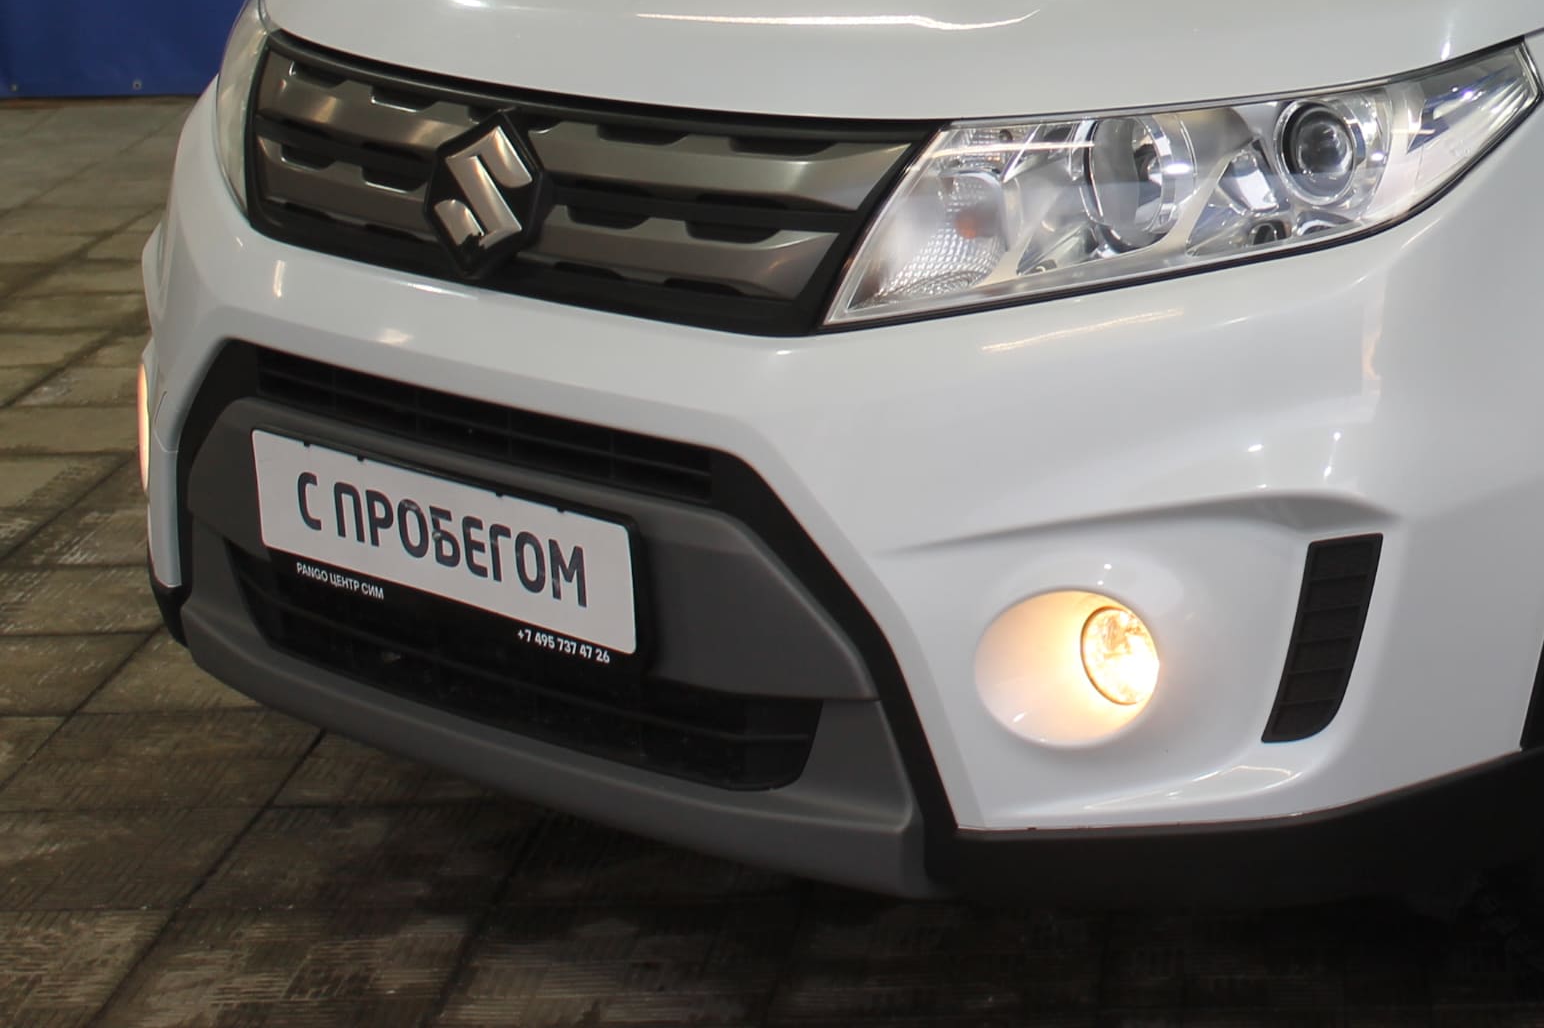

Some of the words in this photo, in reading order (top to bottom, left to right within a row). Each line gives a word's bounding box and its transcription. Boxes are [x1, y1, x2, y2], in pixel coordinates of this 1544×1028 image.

[297, 472, 321, 531] С
[333, 481, 588, 608] ПРОБЕГОМ
[296, 561, 328, 582] PANGO
[329, 573, 360, 591] ЦЕНТР
[361, 582, 385, 600] СИМ
[517, 629, 532, 643] +7
[534, 632, 556, 649] 495
[557, 638, 577, 655] 737
[580, 644, 593, 659] 47
[595, 648, 611, 664] 26
